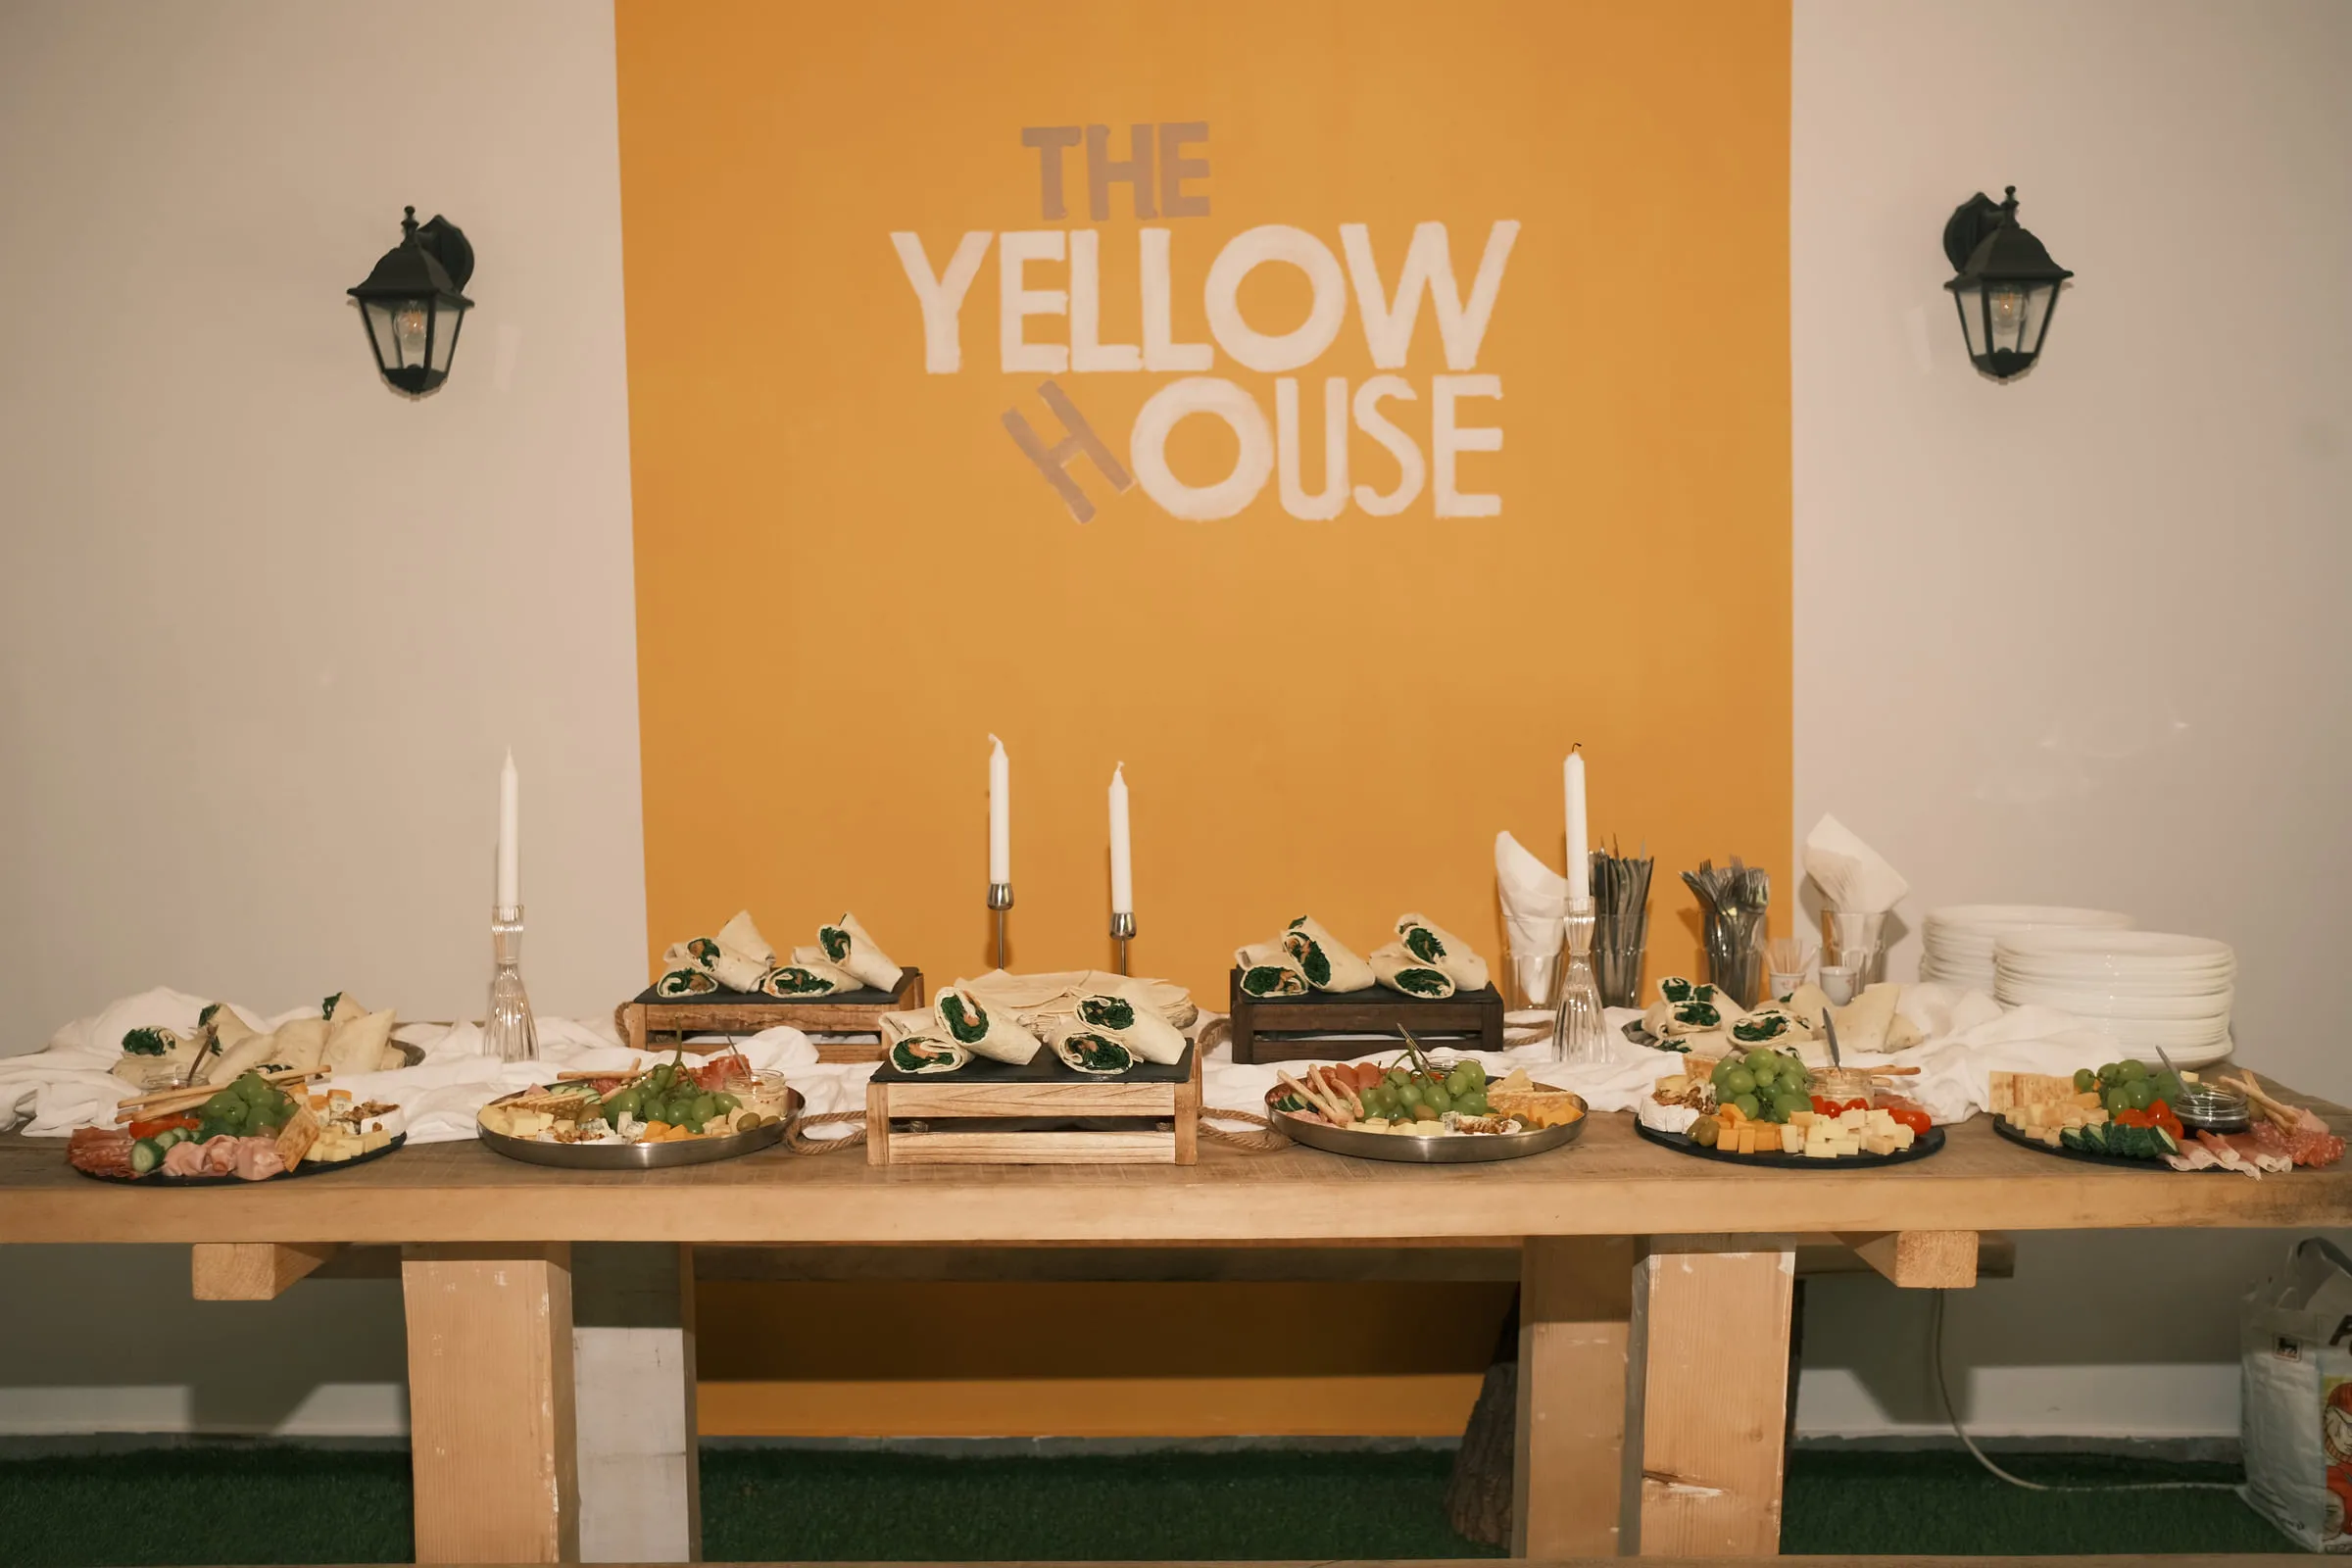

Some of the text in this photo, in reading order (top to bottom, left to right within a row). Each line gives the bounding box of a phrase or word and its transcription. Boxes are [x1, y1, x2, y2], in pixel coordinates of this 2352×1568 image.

[1021, 121, 1210, 221] THE
[889, 220, 1521, 373] YELLOW
[1002, 374, 1504, 524] HOUSE
